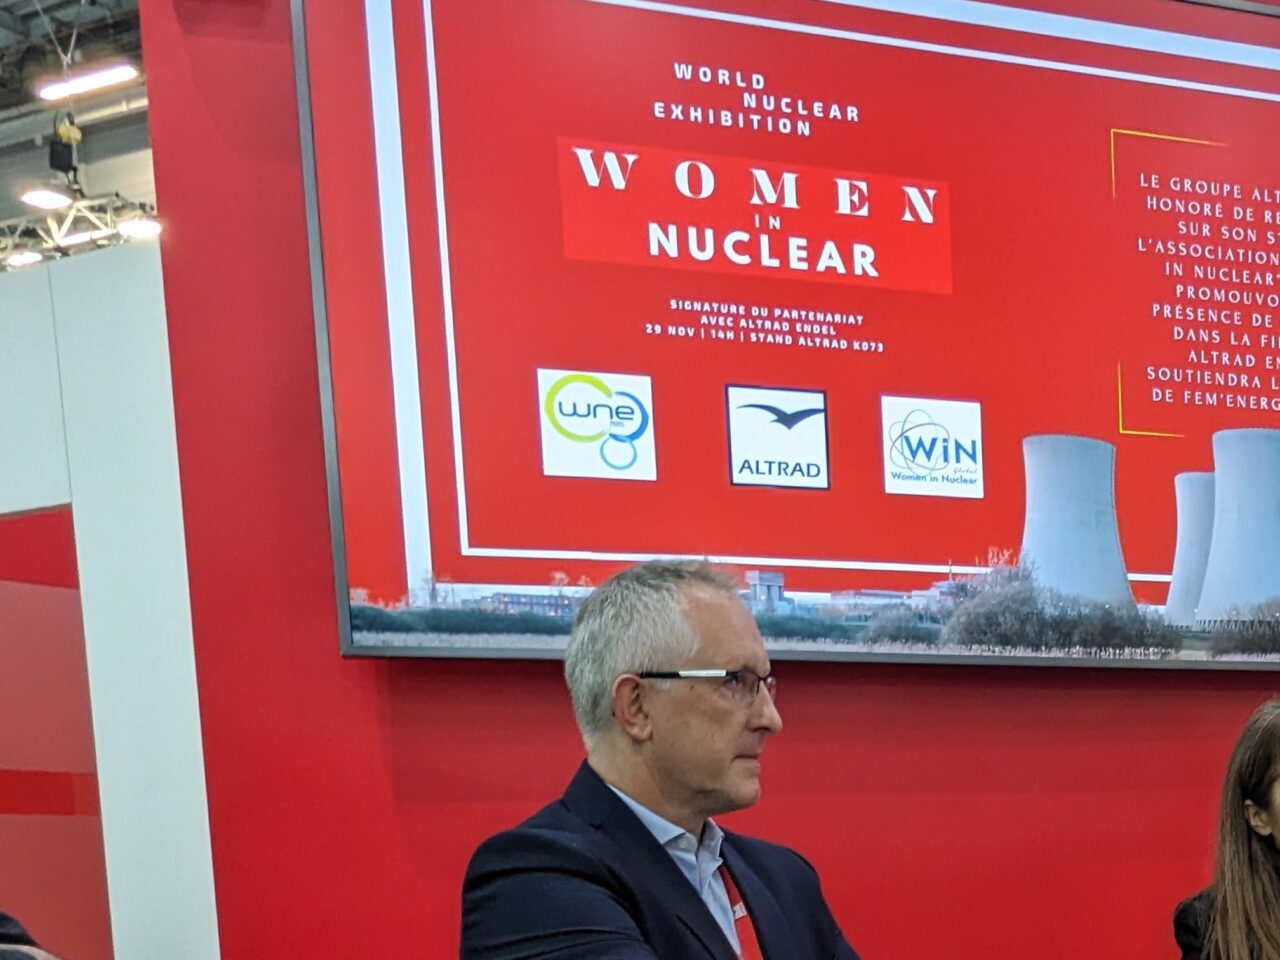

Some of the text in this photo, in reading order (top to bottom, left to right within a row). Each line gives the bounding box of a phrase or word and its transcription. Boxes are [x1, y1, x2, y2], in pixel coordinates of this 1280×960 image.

[674, 62, 765, 90] WORLD
[743, 92, 859, 122] NUCLEAR
[654, 101, 810, 136] EXHIBITION
[572, 147, 938, 224] WOMEN
[1140, 172, 1160, 188] LE
[1170, 177, 1241, 199] GROUPE
[754, 213, 781, 230] IN
[1233, 206, 1254, 221] DE
[1178, 221, 1211, 237] SUR
[1221, 226, 1257, 242] SON
[648, 222, 879, 277] NUCLEAR
[1138, 237, 1279, 266] L'ASSOCIATION
[1165, 261, 1183, 276] IN
[669, 299, 864, 326] SIGNATURE DU PARTENARIAT
[1152, 303, 1242, 325] PRÉSENCE
[1252, 313, 1273, 328] DE
[700, 315, 837, 336] AVEC ALTRAD ENDEL
[1173, 326, 1221, 344] DANS
[1230, 331, 1251, 347] LA
[645, 323, 662, 334] 29
[667, 325, 695, 337] NOV
[711, 329, 734, 341] 14H
[750, 332, 793, 345] STAND
[798, 336, 848, 350] ALTRAD
[853, 341, 884, 353] K073
[1188, 349, 1256, 368] ALTRAD
[1147, 366, 1261, 389] SOUTIENDRA
[1152, 388, 1173, 402] DE
[558, 401, 635, 421] wne
[738, 459, 821, 478] ALTRAD
[891, 471, 978, 484] Women in Nuclear
